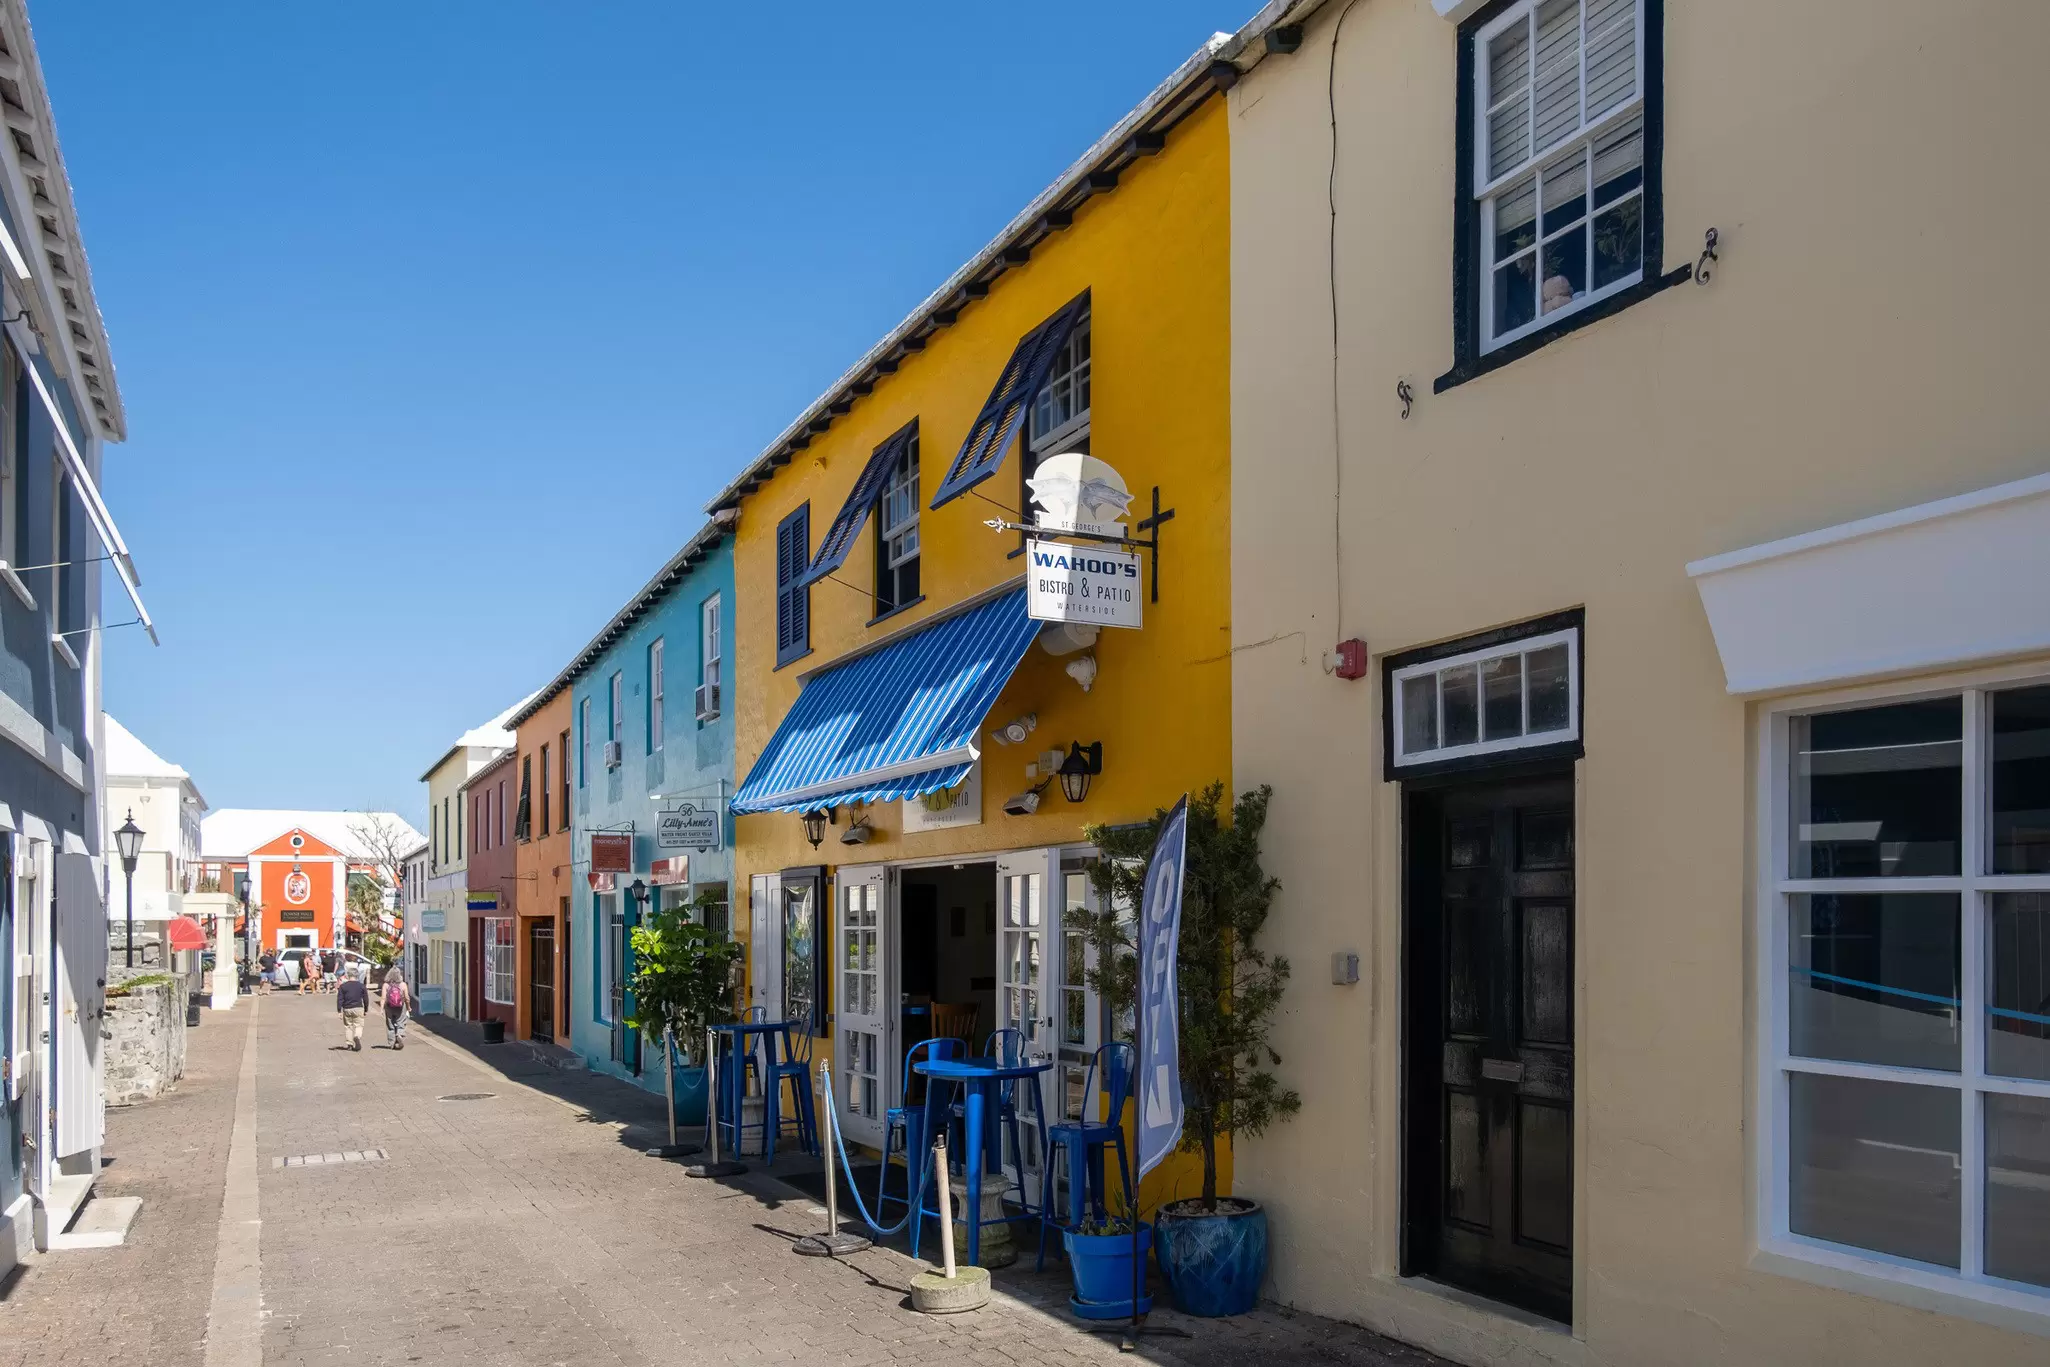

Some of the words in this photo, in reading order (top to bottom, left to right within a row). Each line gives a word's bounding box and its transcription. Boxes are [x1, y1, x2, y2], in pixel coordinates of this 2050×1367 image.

[1072, 522, 1101, 533] GEORGE'S
[1033, 552, 1137, 578] WAHOO'S
[1040, 579, 1074, 596] BISTRO
[1081, 577, 1090, 598] &
[1097, 586, 1131, 603] PATIO
[1057, 602, 1116, 616] WATERSIDE
[681, 807, 693, 817] 36
[661, 817, 713, 830] Lilly-Anne's
